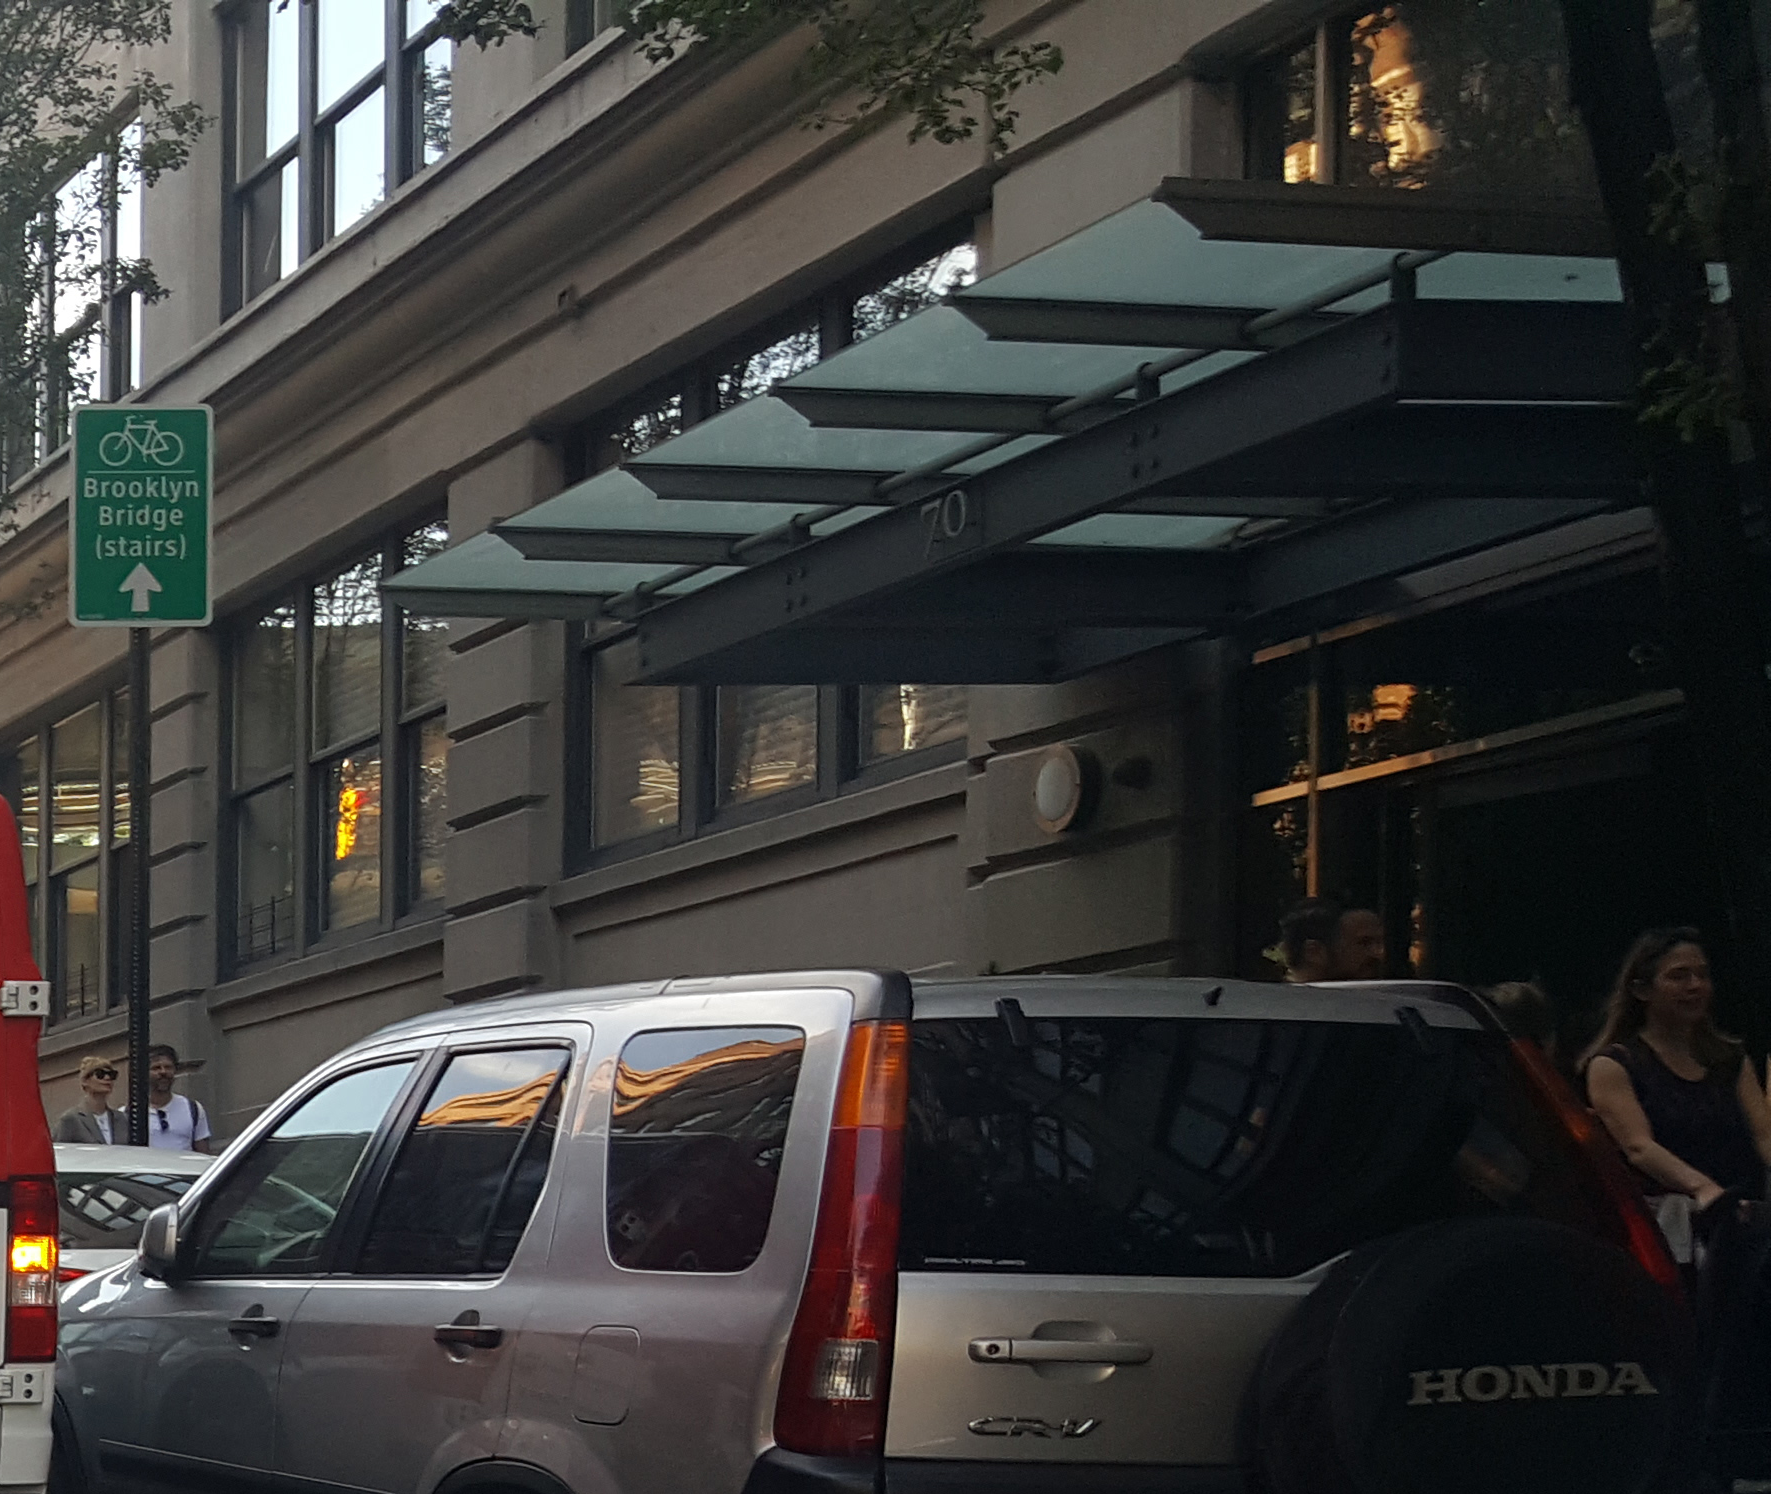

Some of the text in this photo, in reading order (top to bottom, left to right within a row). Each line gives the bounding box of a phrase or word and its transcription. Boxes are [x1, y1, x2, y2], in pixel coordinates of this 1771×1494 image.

[83, 476, 199, 503] Brooklyn
[98, 504, 184, 532] Bridge
[920, 489, 968, 560] 70
[95, 533, 187, 560] (stairs)
[1407, 1361, 1659, 1406] HONDA
[967, 1415, 1102, 1439] CR-V
